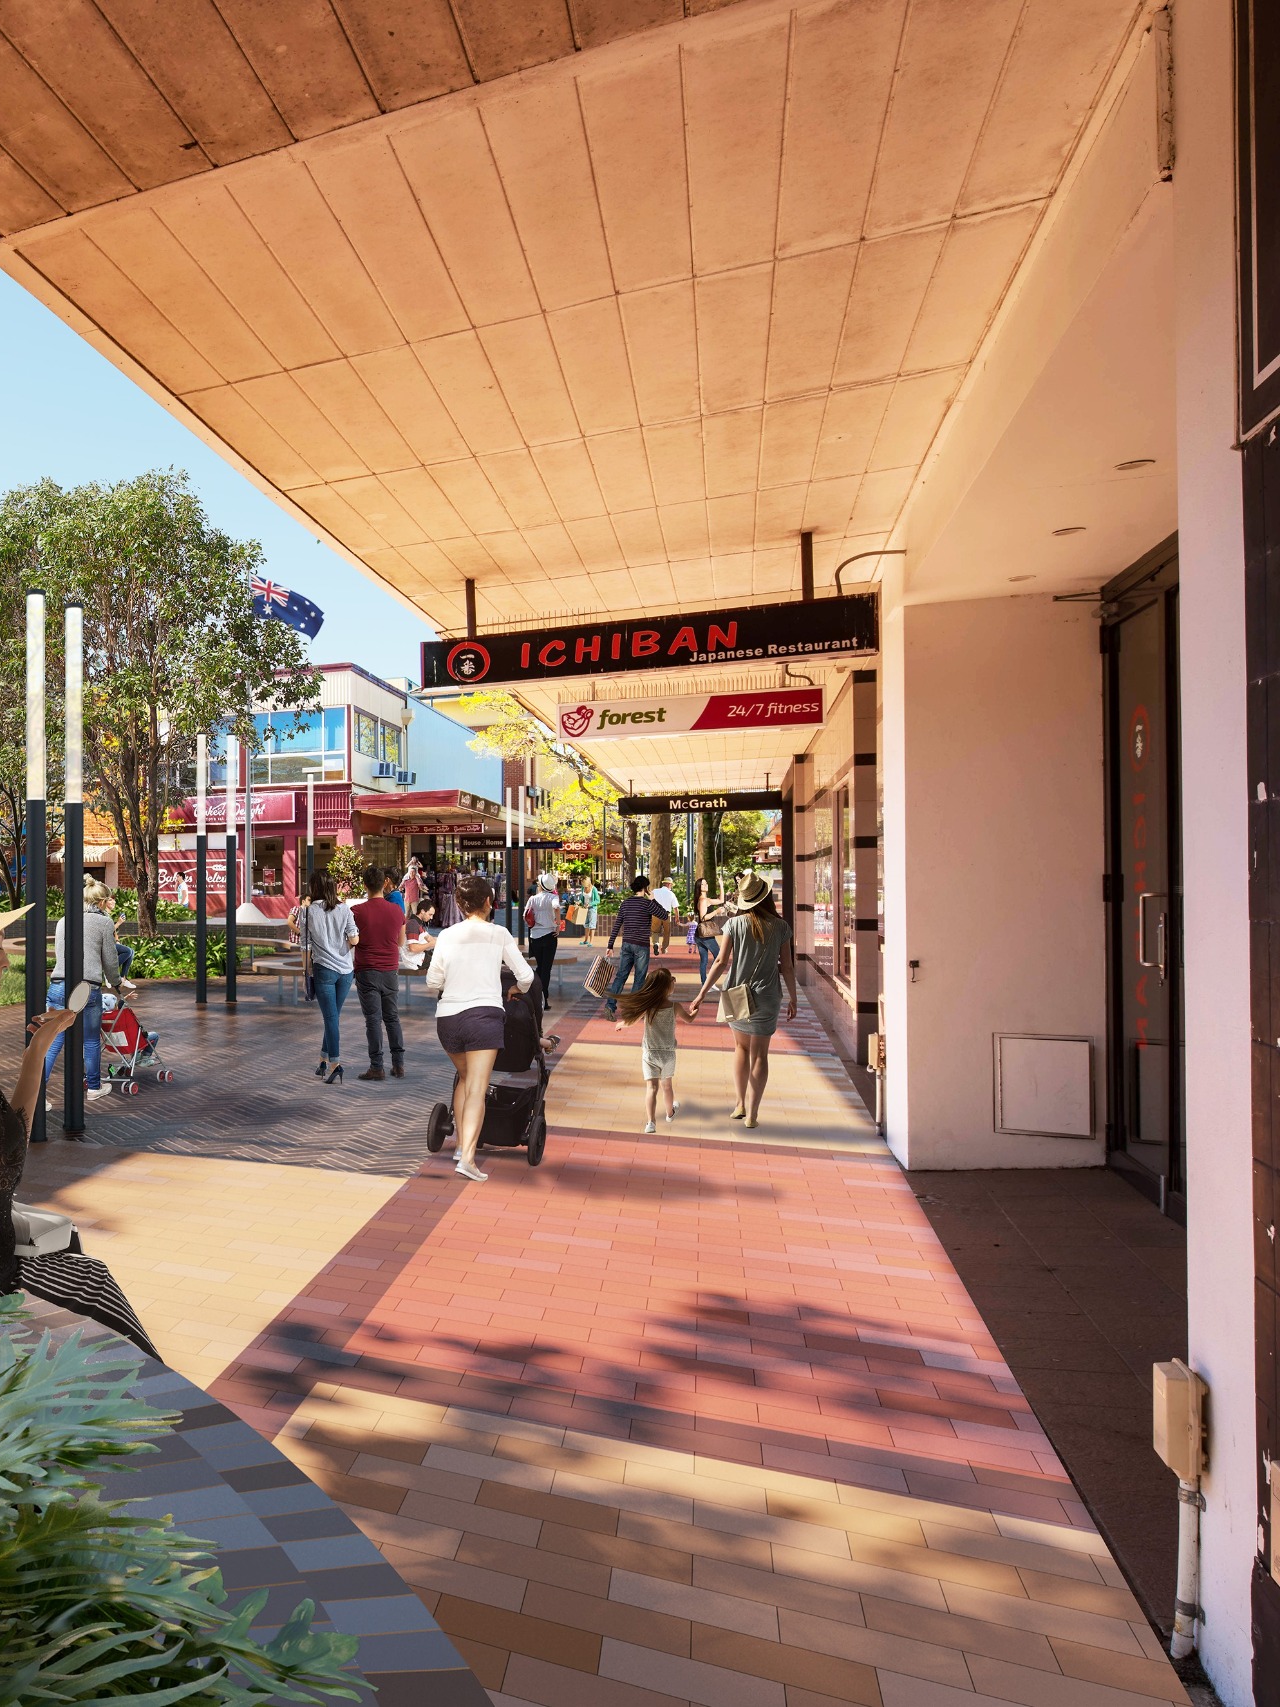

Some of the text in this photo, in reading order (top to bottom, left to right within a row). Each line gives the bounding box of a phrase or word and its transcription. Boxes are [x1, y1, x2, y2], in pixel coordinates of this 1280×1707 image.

[521, 621, 738, 669] ICHIBAN
[689, 636, 858, 663] Japanese Restaurant
[460, 653, 476, 675] 一番
[596, 707, 667, 730] forest
[727, 701, 820, 718] 24/7 fitness
[669, 797, 727, 810] McGrath
